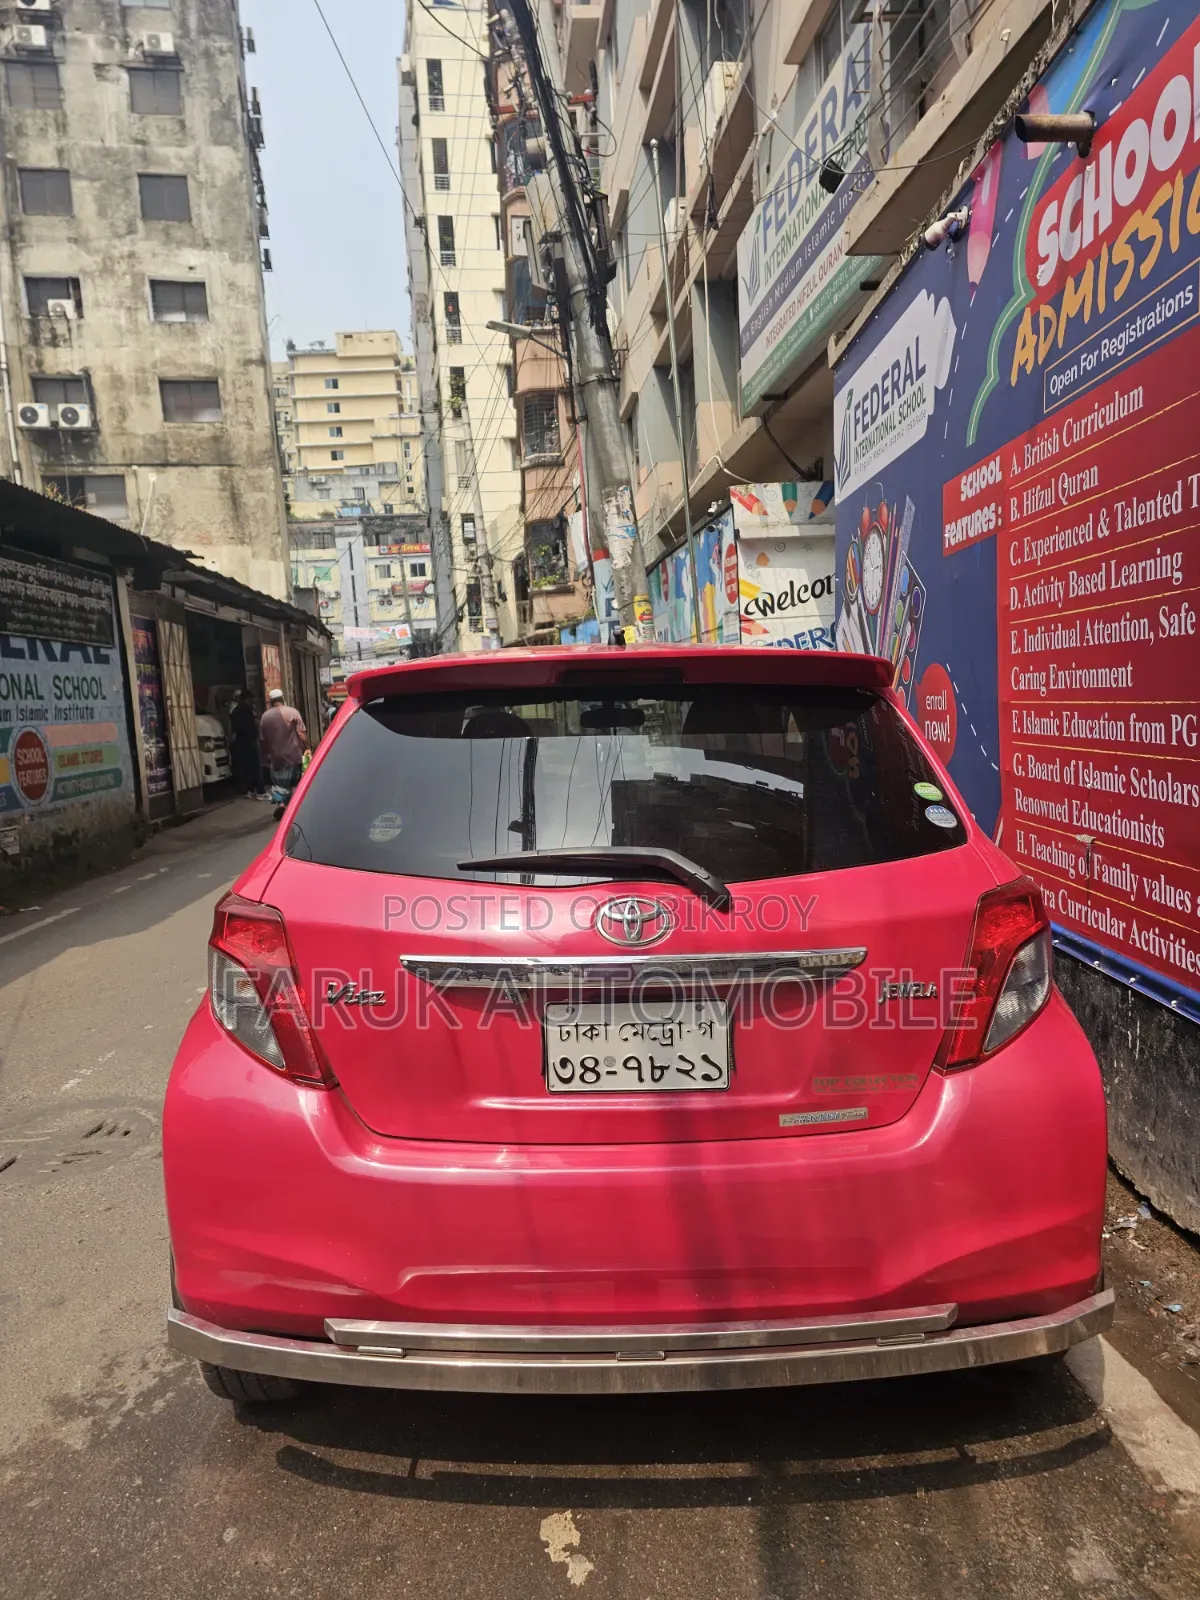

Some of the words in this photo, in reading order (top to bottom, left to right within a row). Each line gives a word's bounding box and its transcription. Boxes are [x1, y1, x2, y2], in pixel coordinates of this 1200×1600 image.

[764, 183, 828, 286] INTERNATIONA
[774, 257, 803, 298] Medium
[804, 210, 836, 261] Islamic
[818, 240, 844, 282] QURAN
[1049, 355, 1079, 396] Open
[1079, 341, 1100, 373] For
[1100, 284, 1194, 364] Registrations
[853, 336, 927, 442] FEDERAL
[853, 410, 897, 465] INTERNATIONAL
[898, 383, 927, 425] SCHOOL
[1009, 454, 1021, 478] A.
[1024, 432, 1059, 476] British
[1062, 385, 1144, 449] Curriculum
[960, 455, 1003, 502] SCHOOL
[1009, 497, 1021, 523] B.
[1023, 479, 1055, 518] Hifzul
[1058, 464, 1099, 505] Quran
[1009, 541, 1021, 566] C.
[1023, 517, 1094, 566] Experienced
[1097, 507, 1110, 538] &
[1113, 480, 1183, 533] Talented
[1009, 586, 1021, 611] D.
[1023, 575, 1065, 609] Activity
[1068, 562, 1106, 598] Based
[1110, 548, 1183, 590] Learning
[1010, 631, 1022, 655] E.
[1023, 621, 1081, 653] Individual
[1083, 610, 1155, 647] Attention,
[1158, 601, 1197, 639] Safe
[52, 674, 107, 701] SCHOOL
[926, 690, 947, 711] enroll
[1010, 666, 1047, 697] Caring
[1048, 662, 1133, 690] Environment
[16, 703, 49, 722] Islamic
[54, 704, 95, 721] Institute
[1011, 710, 1022, 733] F.
[1023, 711, 1060, 737] Islamic
[1062, 711, 1126, 742] Education
[1128, 713, 1166, 745] from
[1170, 713, 1198, 748] PG
[17, 748, 45, 766] SCHOOL
[18, 768, 47, 787] FEATURES
[1013, 752, 1026, 777] G.
[1027, 754, 1061, 783] Board
[1063, 759, 1075, 786] of
[1077, 760, 1127, 795] Islamic
[1129, 767, 1200, 808] Scholars
[1014, 787, 1069, 822] Renowned
[1071, 802, 1165, 848] Educationists
[1016, 829, 1028, 854] H.
[1029, 833, 1076, 879] Teaching
[1093, 853, 1139, 902] Family
[1142, 873, 1192, 914] values
[1058, 888, 1127, 941] Curricular
[326, 981, 387, 1007] Vitz
[877, 980, 938, 1006] JEWELA
[557, 1021, 610, 1043] ঢাকা
[552, 1052, 723, 1085] ৩৪-৭৮২১
